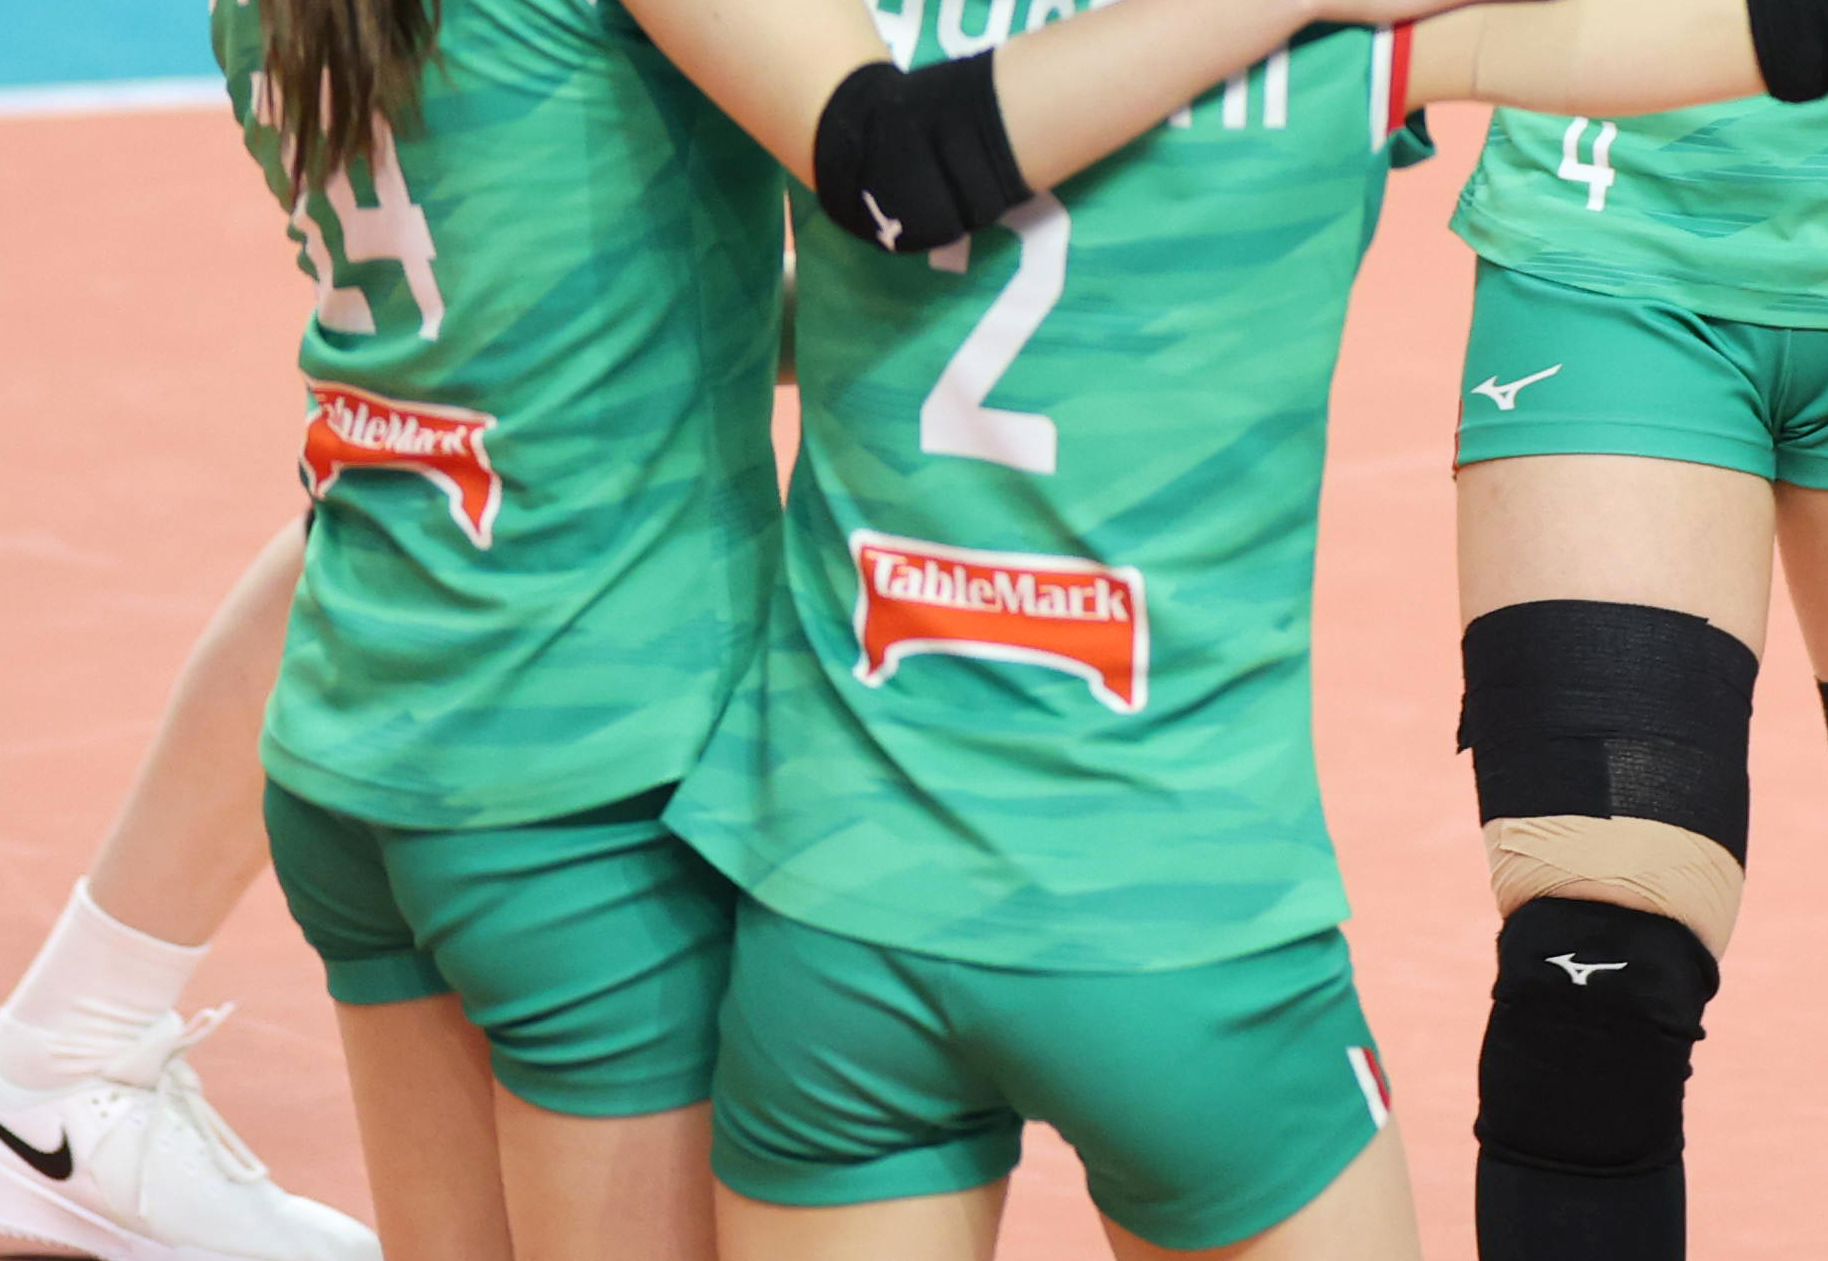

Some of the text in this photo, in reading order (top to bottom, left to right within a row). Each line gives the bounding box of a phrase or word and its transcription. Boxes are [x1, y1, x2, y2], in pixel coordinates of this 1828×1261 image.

[1557, 116, 1618, 211] 4
[920, 190, 1072, 476] 2
[864, 550, 1130, 623] TableMark
